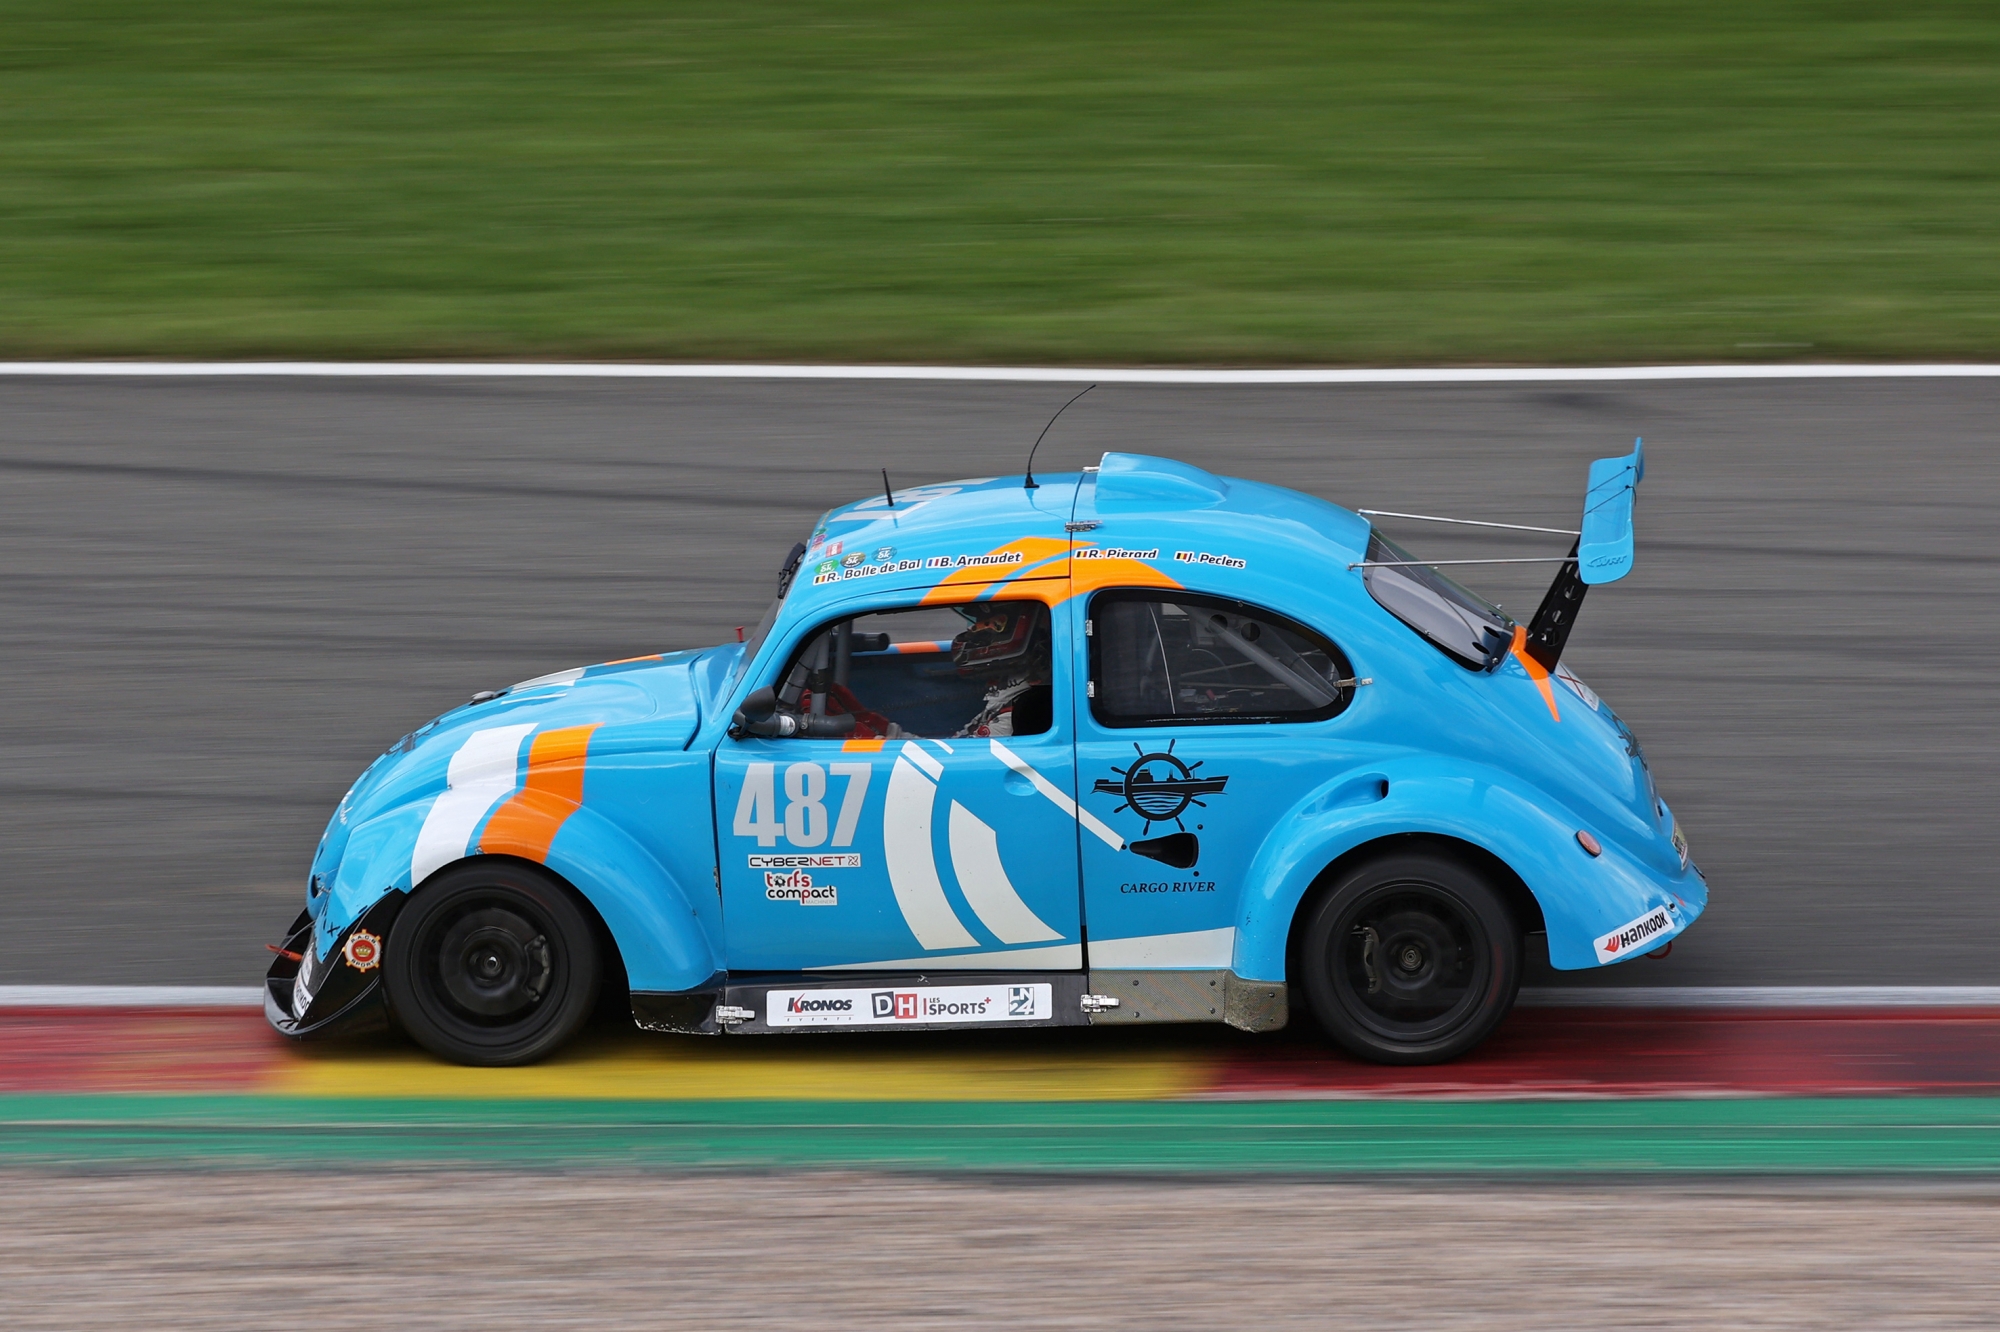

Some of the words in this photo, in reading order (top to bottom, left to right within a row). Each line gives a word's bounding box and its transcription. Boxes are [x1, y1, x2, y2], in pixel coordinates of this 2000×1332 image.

[939, 557, 953, 567] B.
[957, 552, 1022, 566] Arnaudet
[1088, 549, 1102, 558] R.
[1106, 549, 1157, 559] Pierard
[1186, 552, 1196, 562] J.
[1199, 553, 1245, 568] Peclers
[826, 572, 841, 582] R.
[844, 565, 878, 579] Bolle
[879, 562, 896, 574] de
[899, 558, 921, 571] Bal
[733, 762, 872, 847] 487
[749, 856, 846, 866] CYBERNET
[767, 885, 835, 904] compact
[1120, 882, 1168, 893] CARGO
[1172, 882, 1216, 892] RIVER
[787, 993, 853, 1013] KRONOS
[873, 994, 916, 1017] DH
